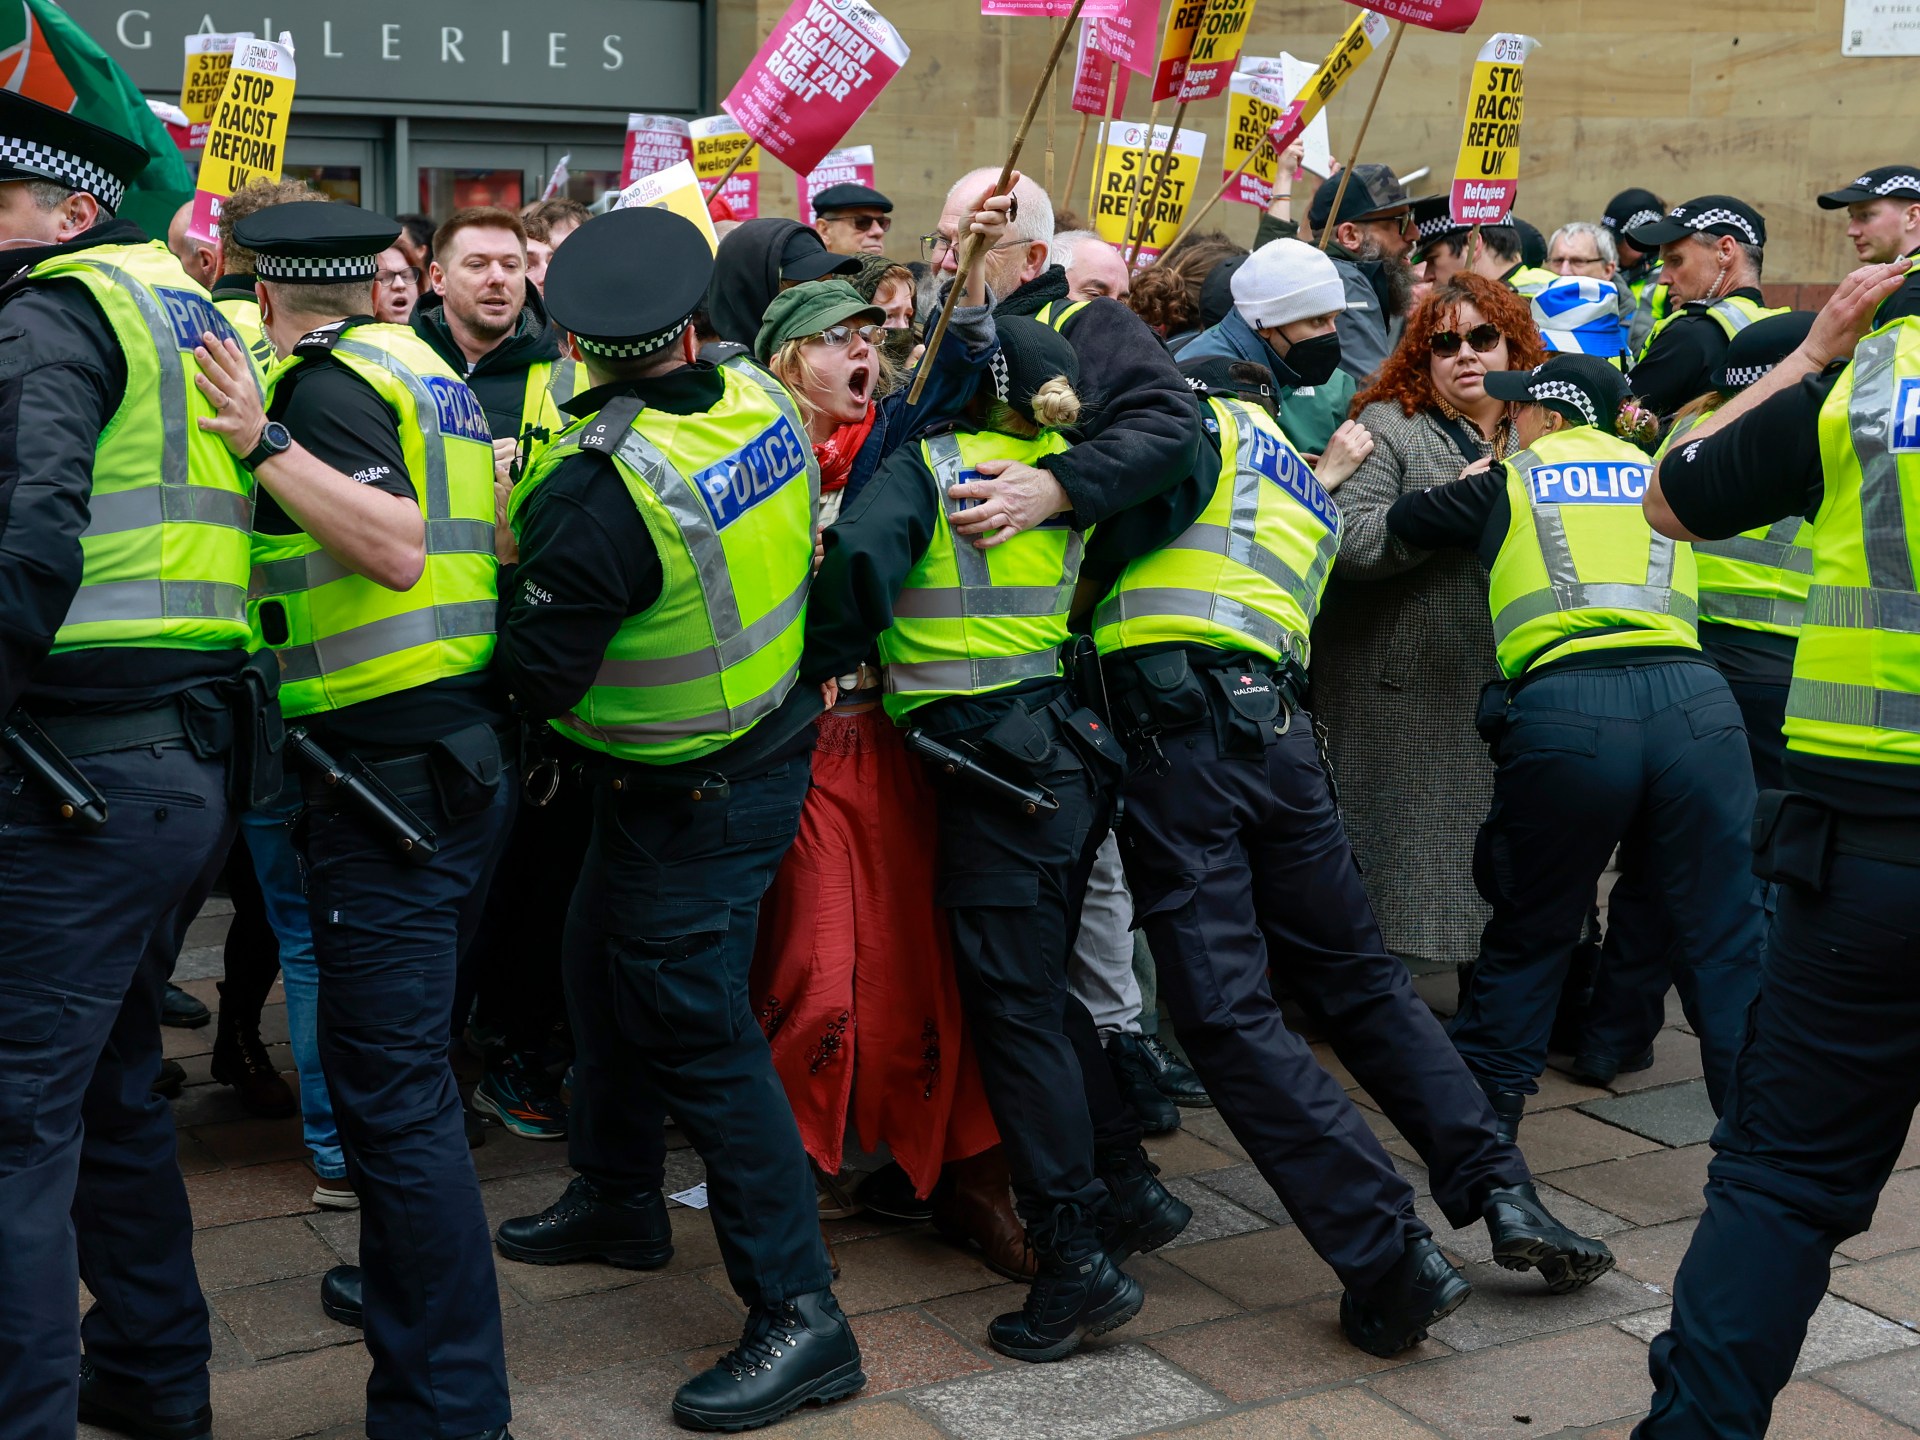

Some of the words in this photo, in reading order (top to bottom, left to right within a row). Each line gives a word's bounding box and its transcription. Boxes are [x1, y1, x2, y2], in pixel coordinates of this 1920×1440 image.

[852, 2, 876, 25] STAND
[1398, 2, 1434, 22] blame
[805, 0, 876, 65] WOMEN
[847, 9, 859, 22] TO
[857, 18, 886, 46] RACISM
[250, 46, 268, 59] STAND
[267, 49, 278, 60] UP
[790, 18, 872, 89] AGAINST
[1508, 40, 1523, 50] STA
[1508, 50, 1517, 60] TO
[249, 56, 256, 68] TO
[256, 59, 278, 72] RACISM
[779, 32, 817, 73] THE
[810, 62, 851, 103] FAR
[764, 50, 822, 103] RIGHT
[231, 73, 274, 106] STOP
[751, 85, 775, 110] racist
[772, 105, 792, 124] lies
[1248, 98, 1279, 125] SOP
[218, 101, 278, 139] RACIST
[634, 131, 682, 147] WOMEN
[736, 107, 750, 124] not
[749, 119, 758, 132] to
[756, 129, 785, 154] blame
[778, 128, 796, 147] are
[1142, 129, 1168, 140] SAND
[209, 130, 277, 171] REFORM
[633, 143, 689, 160] AGAINST
[1153, 140, 1183, 152] RACM
[631, 155, 656, 169] THE
[1480, 151, 1507, 176] UK
[228, 164, 250, 192] UK
[641, 179, 655, 191] UP
[727, 175, 751, 192] the
[806, 166, 857, 184] WOMEN
[628, 186, 663, 208] RACISM
[596, 424, 607, 433] G
[583, 434, 605, 446] 195
[353, 466, 391, 481] OILEAS
[703, 424, 802, 520] POLICE
[1254, 433, 1337, 527] POLICE
[1232, 685, 1270, 696] NALOXONE
